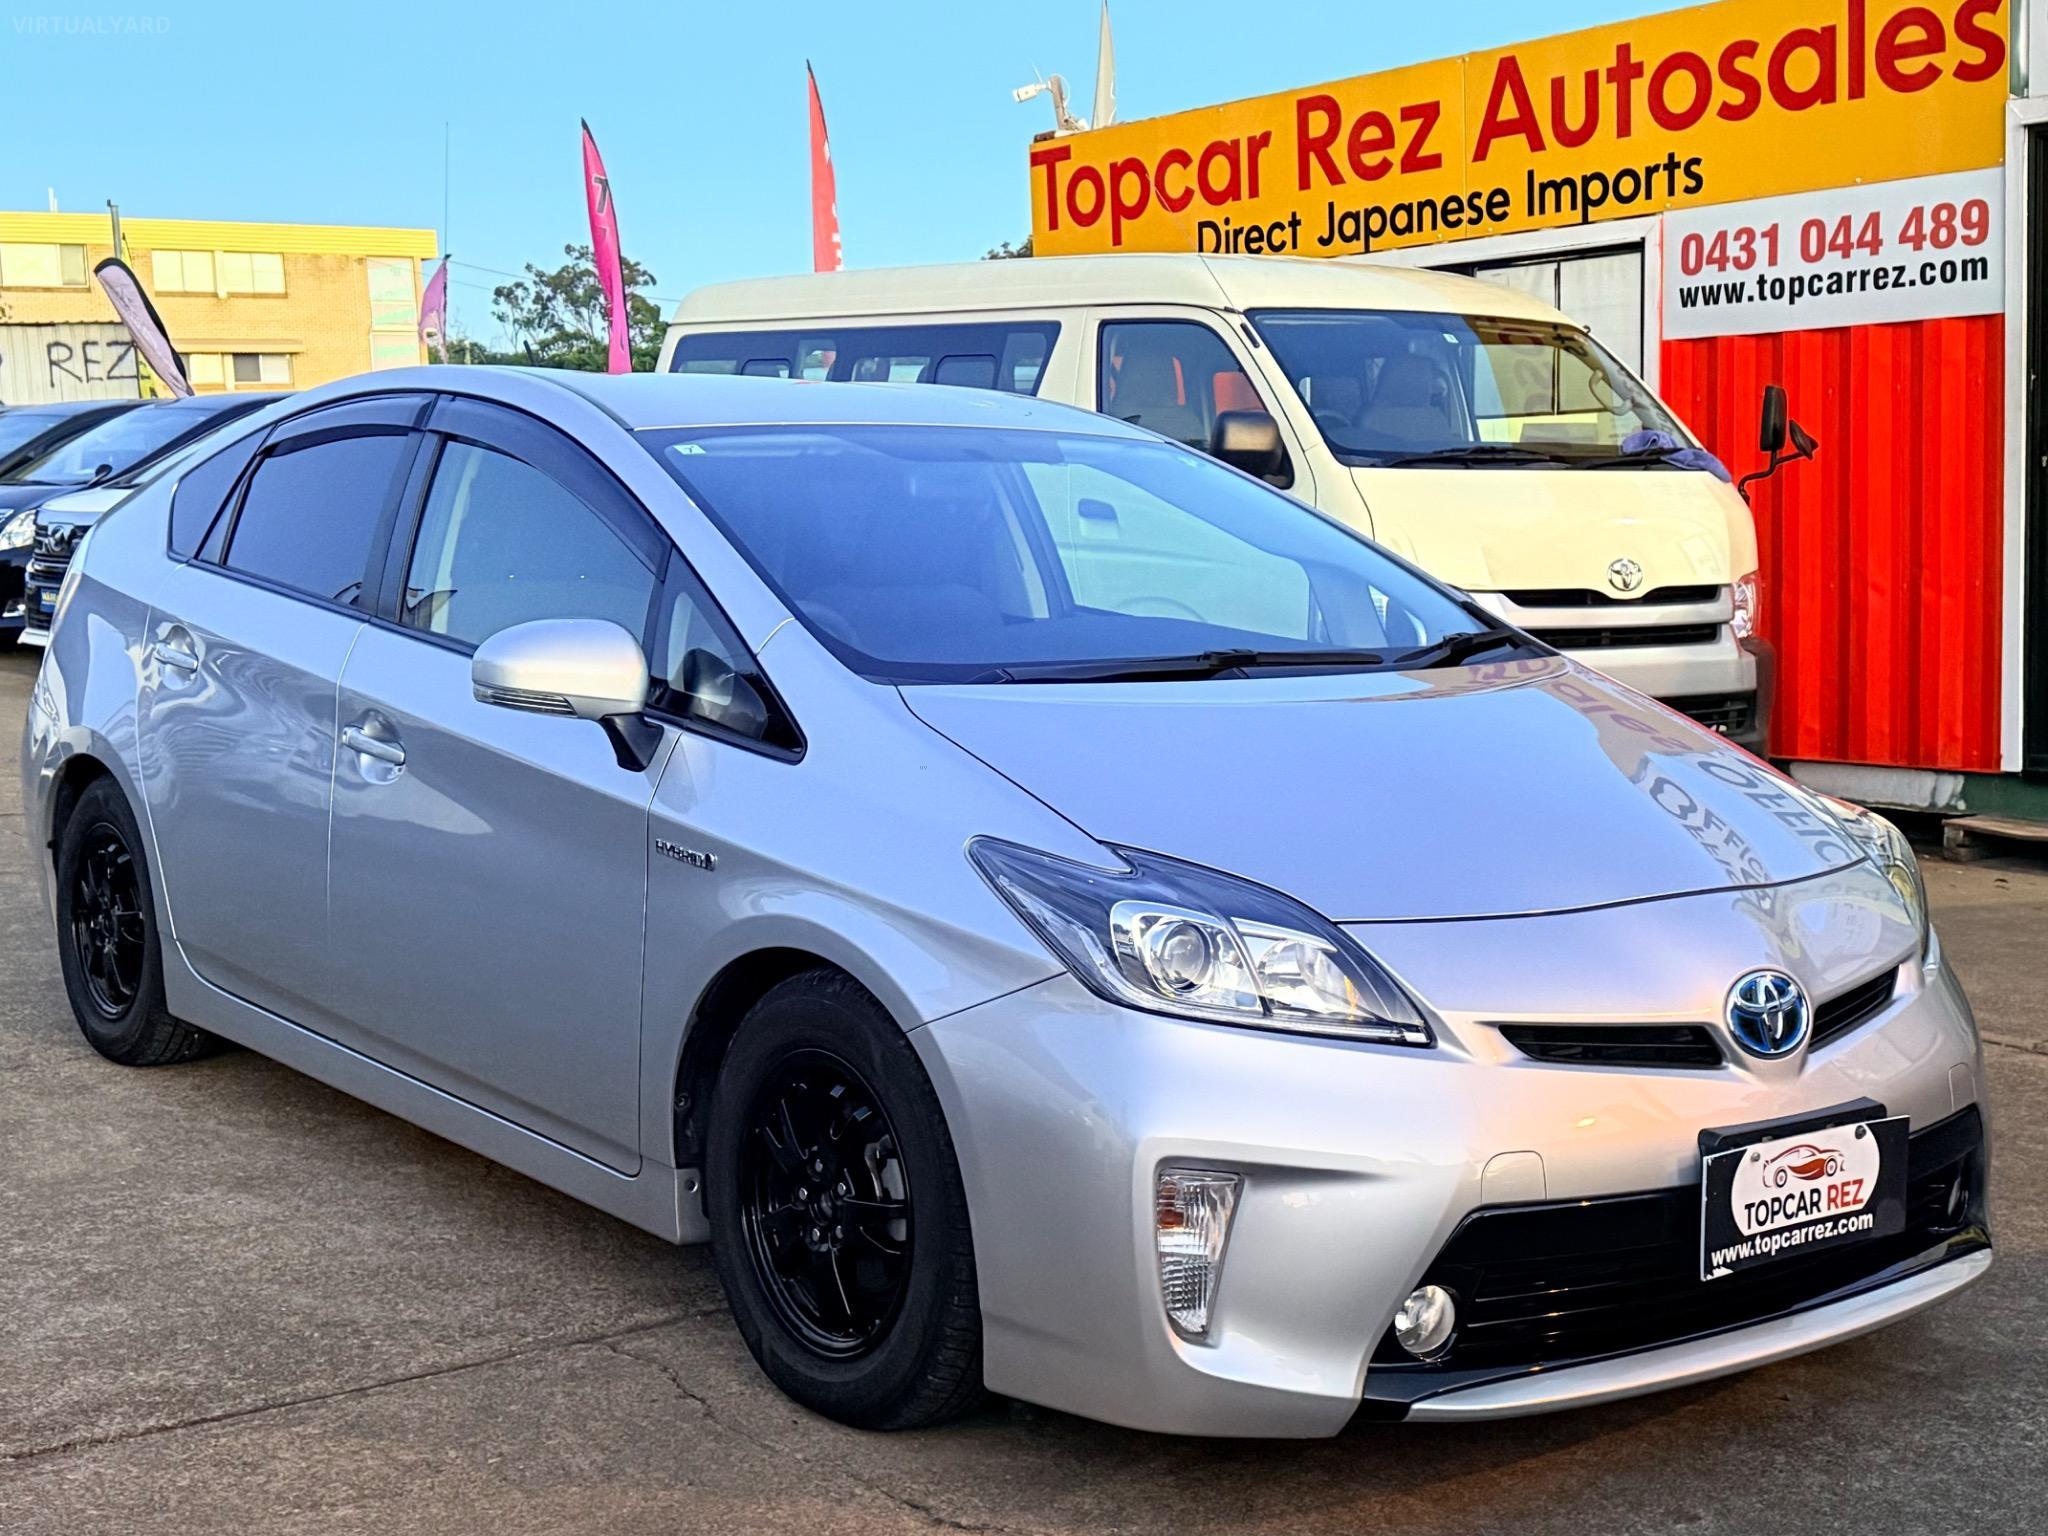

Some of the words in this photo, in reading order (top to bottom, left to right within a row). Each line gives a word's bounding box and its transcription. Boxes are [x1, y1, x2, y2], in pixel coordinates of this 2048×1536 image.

[1031, 130, 1272, 247] Topcar
[1296, 94, 1442, 191] Rez
[1472, 0, 2006, 162] Autosales
[1198, 212, 1301, 255] Direct
[1317, 188, 1510, 253] Japanese
[1527, 153, 1703, 222] Imports
[1680, 223, 1779, 276] 0431
[1800, 212, 1883, 263] 044
[1899, 199, 1989, 251] 489
[1679, 256, 1989, 308] www.topcarrez.com
[47, 341, 138, 388] REZ
[656, 839, 707, 869] HYBRID
[1745, 1188, 1821, 1230] TOPCAR
[1827, 1179, 1864, 1210] REZ
[1711, 1213, 1873, 1266] www.topcarrez.com
